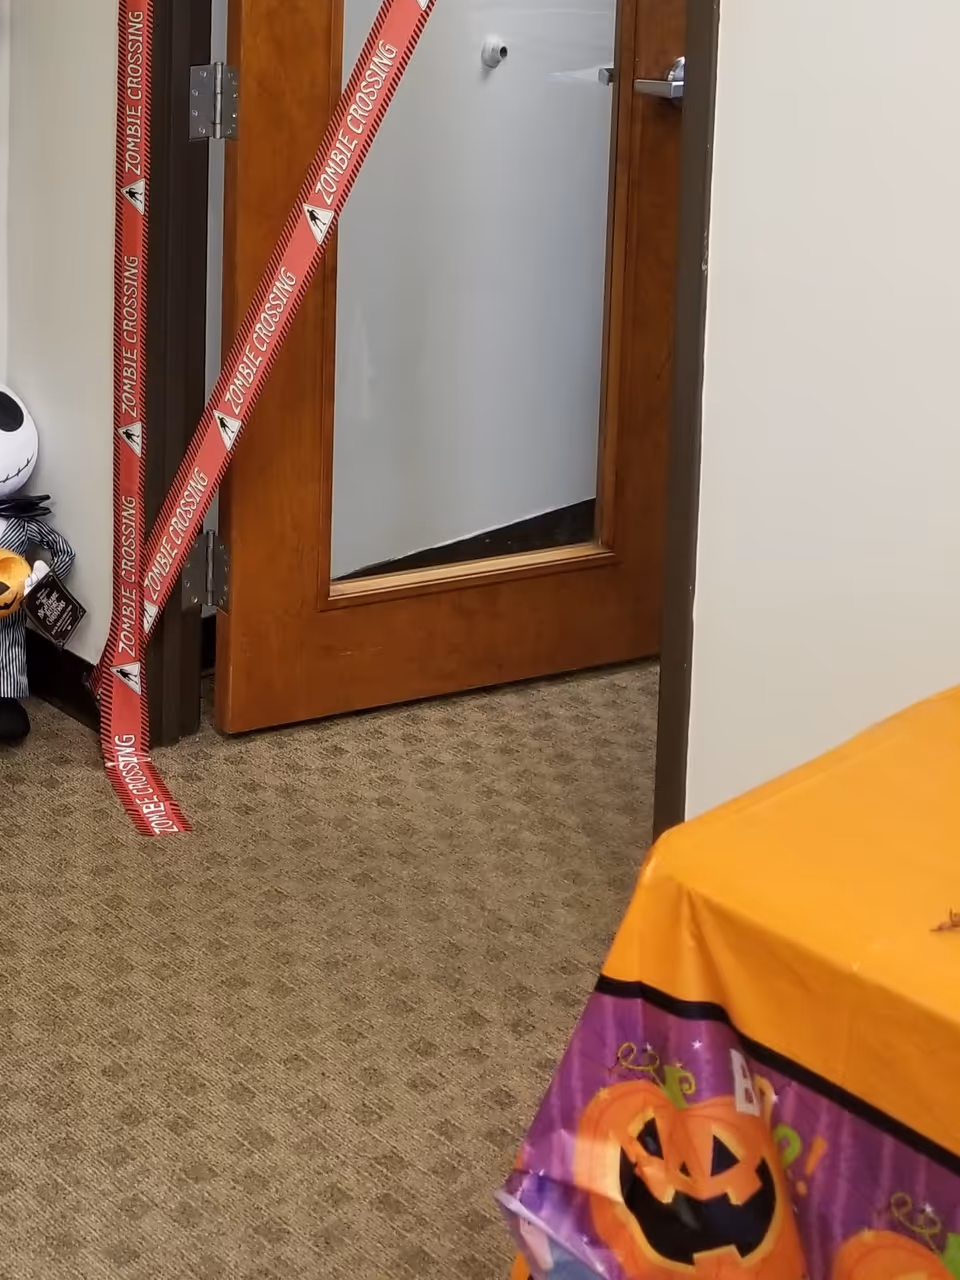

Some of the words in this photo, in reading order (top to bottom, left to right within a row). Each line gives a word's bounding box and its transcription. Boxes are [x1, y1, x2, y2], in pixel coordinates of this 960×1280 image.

[126, 10, 144, 100] CROSSING
[125, 105, 142, 175] ZOMBIE
[315, 128, 358, 206] ZOMBIE
[347, 39, 397, 135] CROSSING
[122, 255, 139, 343] CROSSING
[224, 347, 263, 415] ZOMBIE
[252, 266, 297, 353] CROSSING
[121, 345, 138, 418] ZOMBIE
[120, 495, 137, 580] CROSSING
[143, 535, 178, 601] ZOMBIE
[168, 466, 209, 543] CROSSING
[118, 584, 137, 658] ZOMBIE
[114, 734, 154, 795] CROSSING
